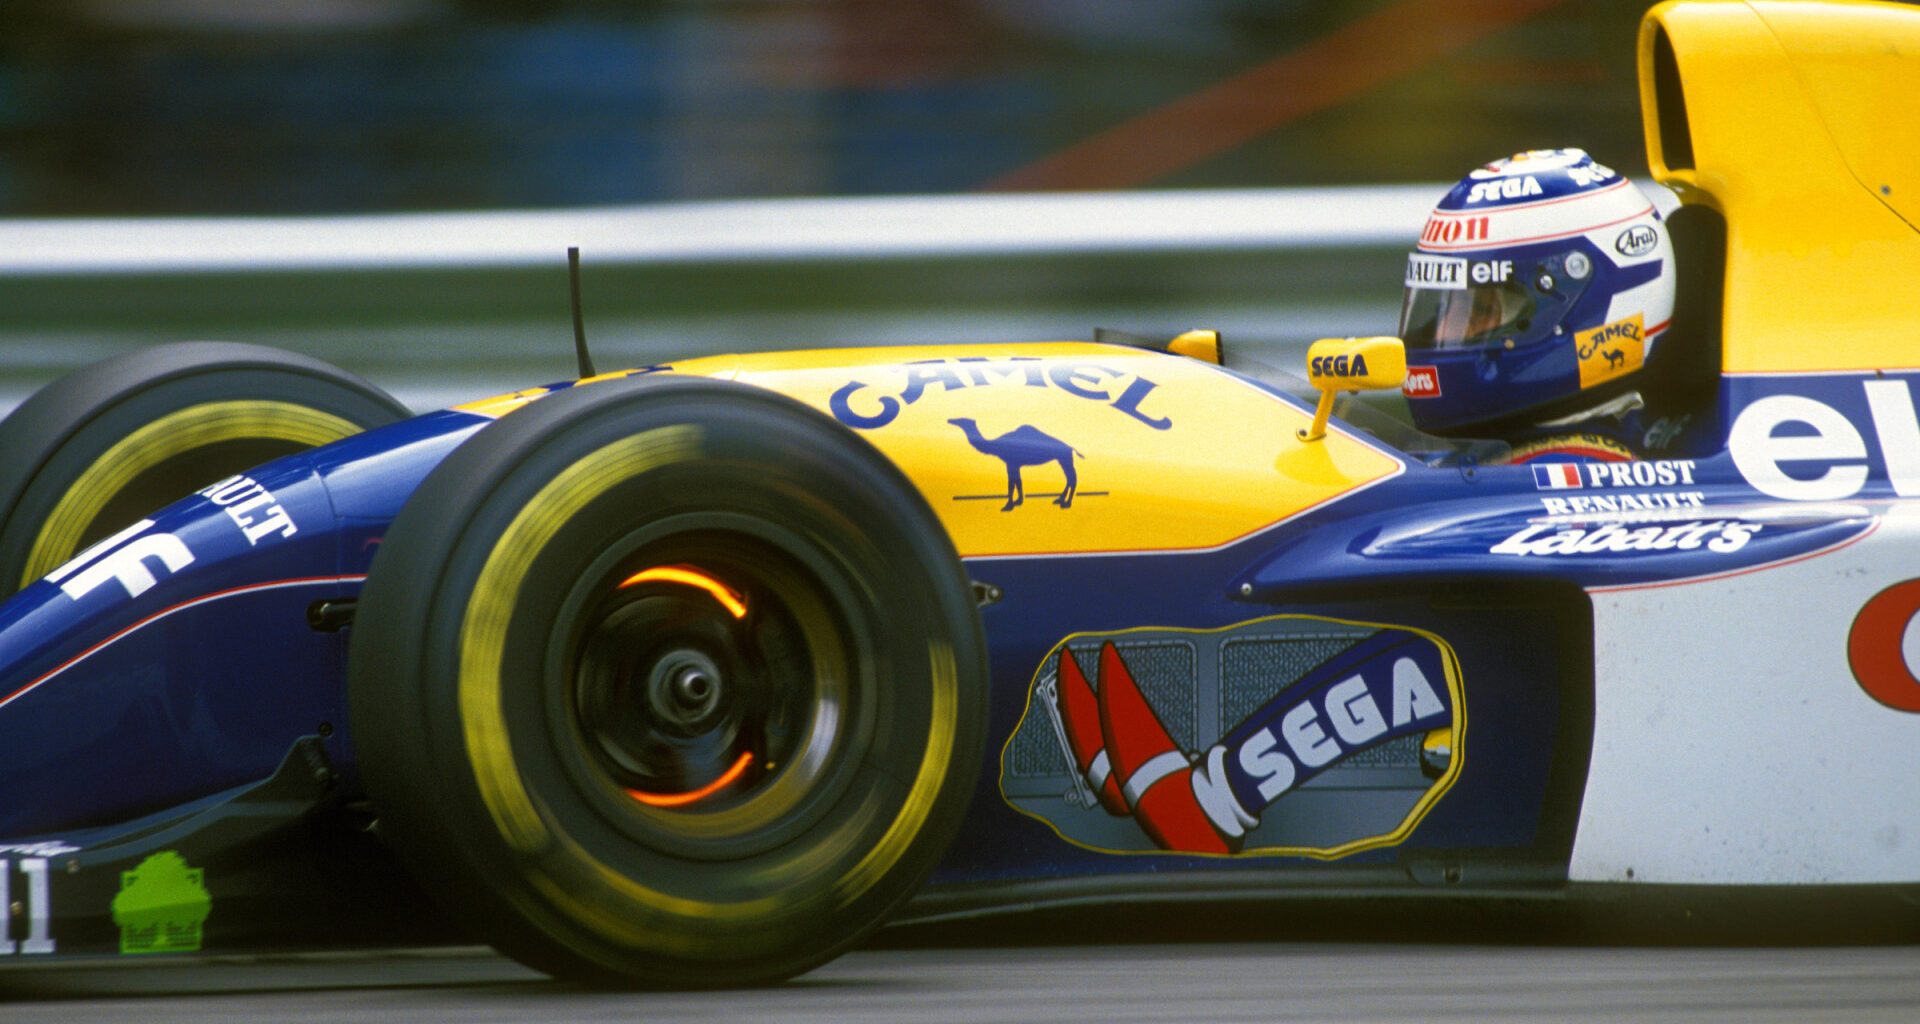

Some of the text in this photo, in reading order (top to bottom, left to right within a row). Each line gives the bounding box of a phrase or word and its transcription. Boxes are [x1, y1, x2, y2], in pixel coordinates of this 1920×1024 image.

[1466, 176, 1543, 204] SEGA
[1578, 322, 1642, 361] CAMEL
[1311, 353, 1369, 377] SEGA
[828, 357, 1173, 430] CAMEL
[1585, 460, 1696, 487] PROST
[1540, 492, 1704, 515] RENAULT
[1489, 519, 1763, 556] Labatt's
[1239, 657, 1445, 803] SEGA
